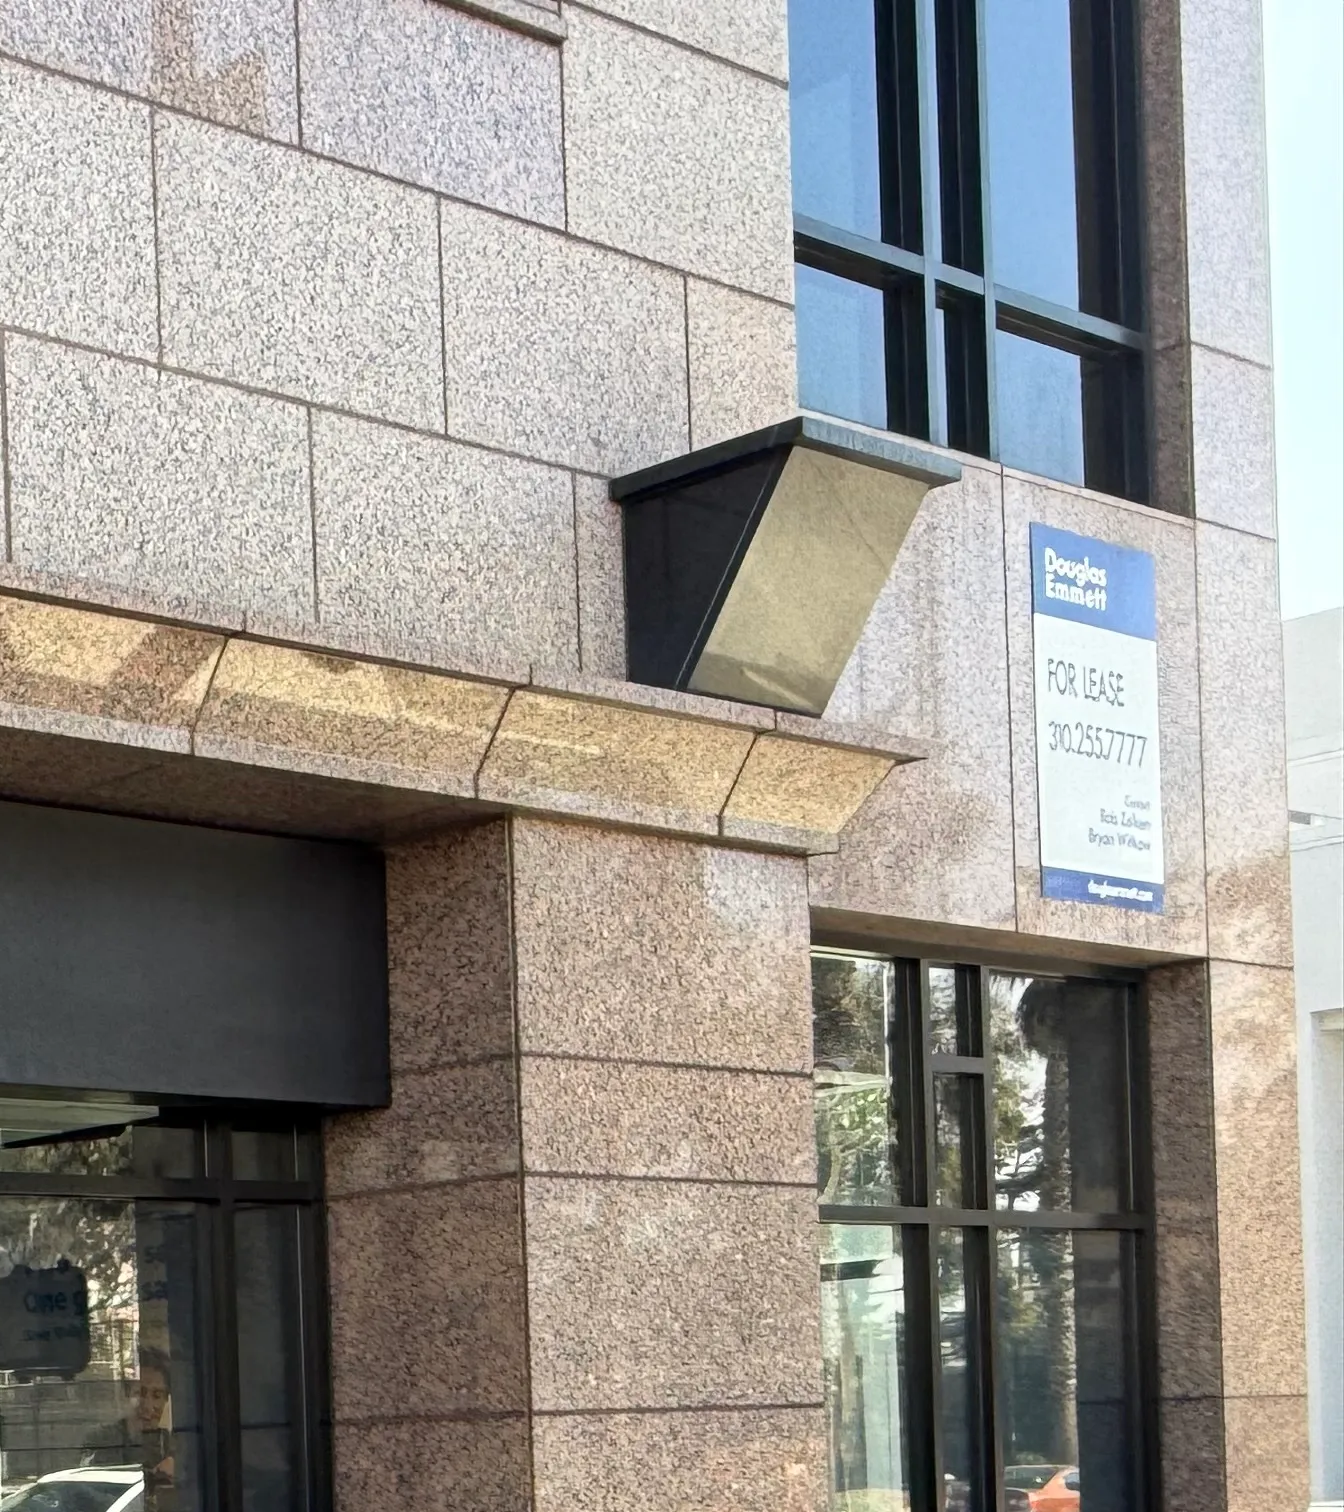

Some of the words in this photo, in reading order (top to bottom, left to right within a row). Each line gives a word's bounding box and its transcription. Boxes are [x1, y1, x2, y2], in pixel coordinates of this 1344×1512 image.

[1044, 547, 1108, 587] Douglas
[1045, 572, 1108, 611] Emmett
[1047, 658, 1078, 699] FOR
[1082, 666, 1125, 707] LEASE
